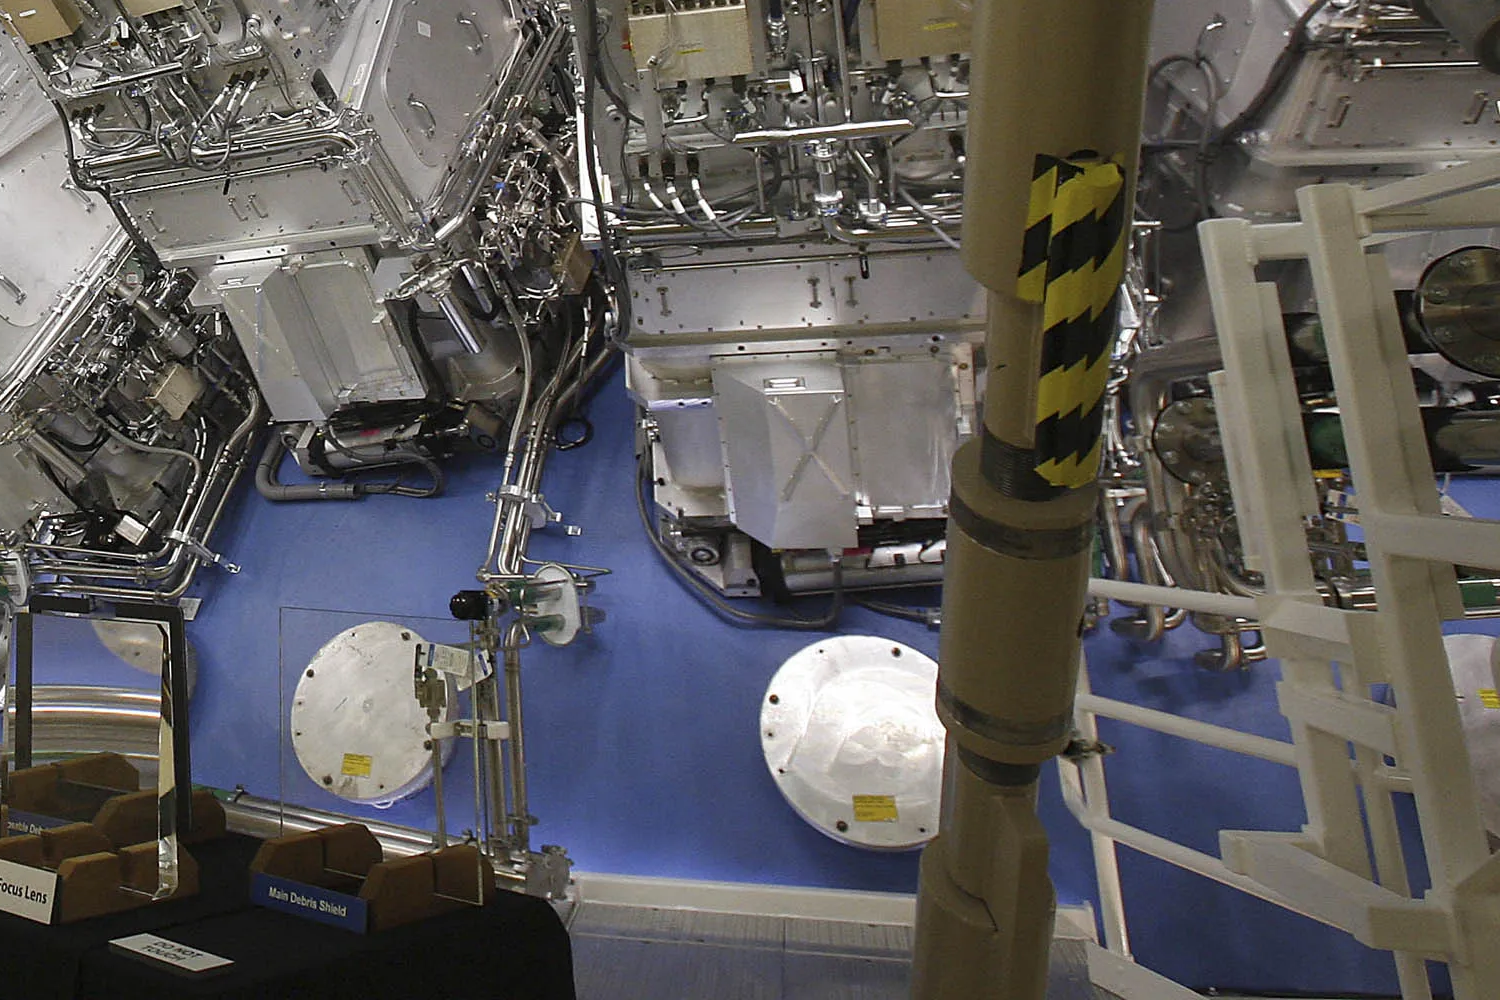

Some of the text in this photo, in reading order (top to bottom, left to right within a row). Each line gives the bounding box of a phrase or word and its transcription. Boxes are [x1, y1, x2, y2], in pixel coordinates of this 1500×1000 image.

[25, 886, 48, 904] Lens
[268, 886, 347, 917] Main Debris Shield
